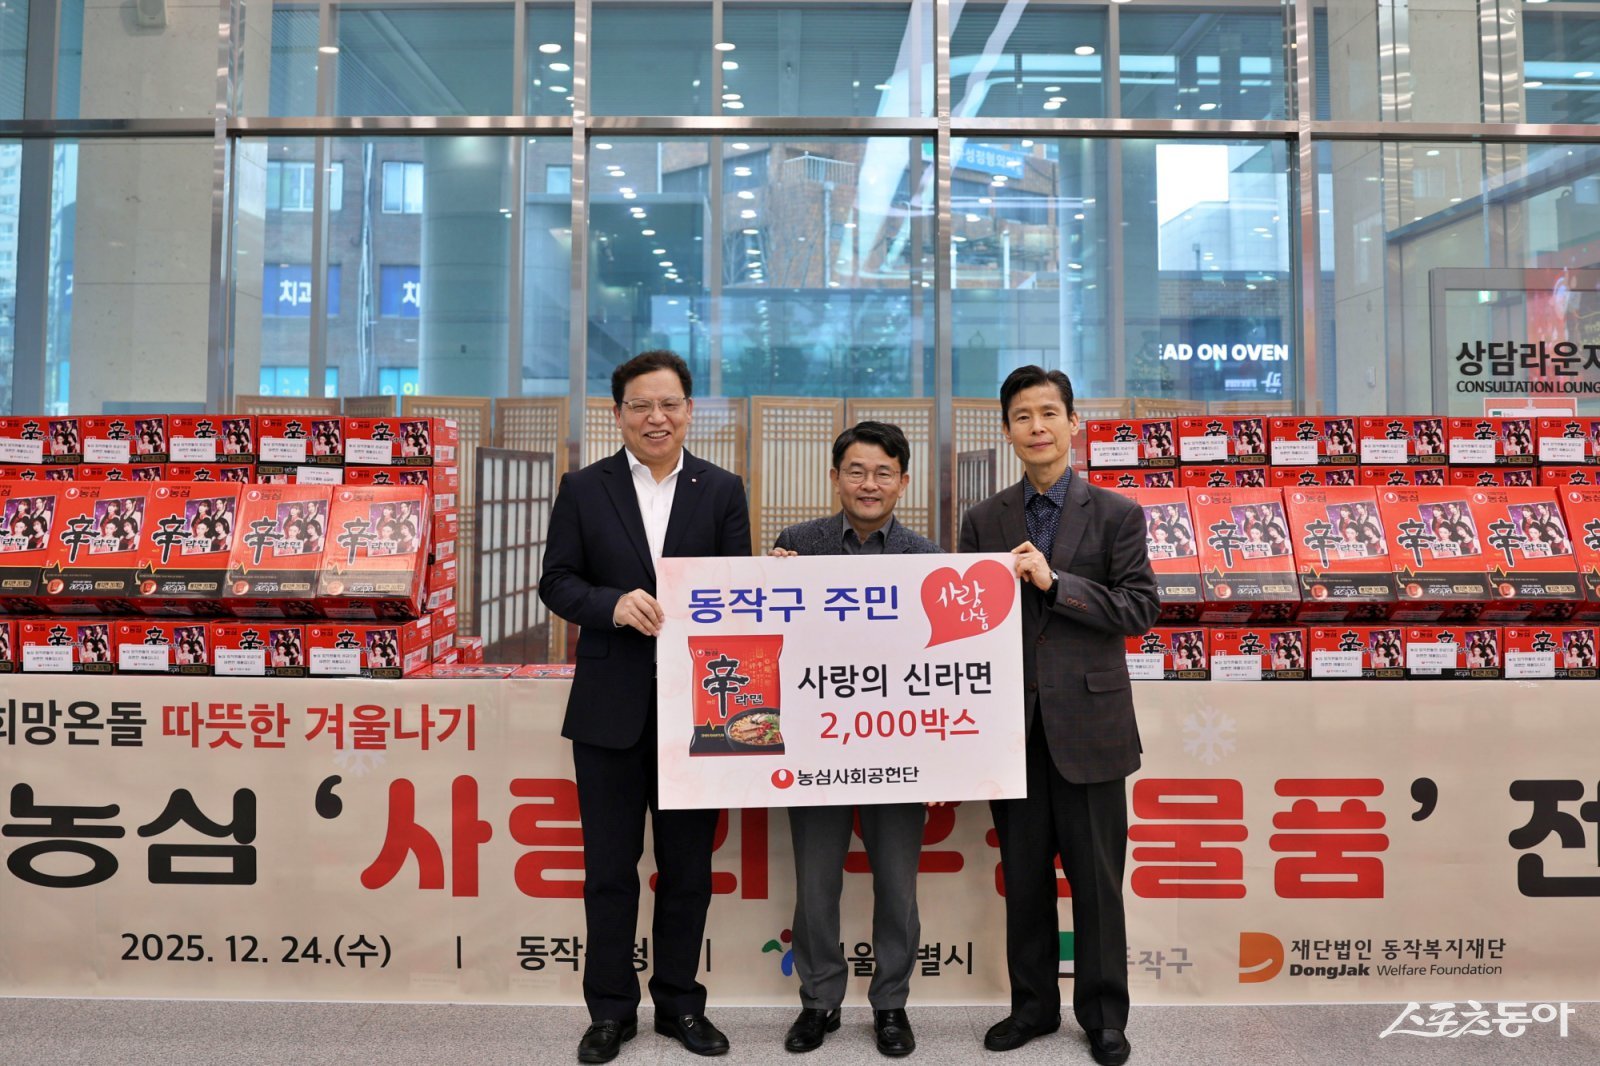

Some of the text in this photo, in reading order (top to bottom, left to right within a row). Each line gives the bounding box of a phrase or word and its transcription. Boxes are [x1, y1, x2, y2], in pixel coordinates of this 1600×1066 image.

[1197, 343, 1227, 360] ON
[1231, 343, 1289, 360] OVEN
[1456, 380, 1554, 393] CONSULTATION
[61, 513, 100, 563] 辛
[152, 513, 192, 565] 辛
[243, 516, 284, 566] 辛
[338, 516, 378, 566] 辛
[1207, 520, 1248, 568] 辛
[1305, 520, 1344, 568] 辛
[1397, 518, 1437, 568] 辛
[1487, 518, 1527, 568] 辛
[688, 585, 899, 624] 동작구 주민
[936, 580, 986, 609] 사랑
[960, 609, 989, 631] 나눔
[702, 654, 750, 719] 辛
[735, 693, 764, 706] 라면
[797, 661, 992, 699] 사랑의 신라면
[161, 701, 290, 749] 따뜻한
[304, 703, 477, 751] 겨울나기
[820, 706, 980, 745] 2,000박스
[797, 766, 919, 787] 농심사회공헌단
[1, 782, 257, 888] 농심
[121, 933, 391, 968] 2025. 12. 24.(수)
[840, 942, 973, 977] 울별시
[1291, 937, 1507, 962] 재단법인 동작복지재단
[1290, 963, 1502, 978] DongJak Welfare Foundation
